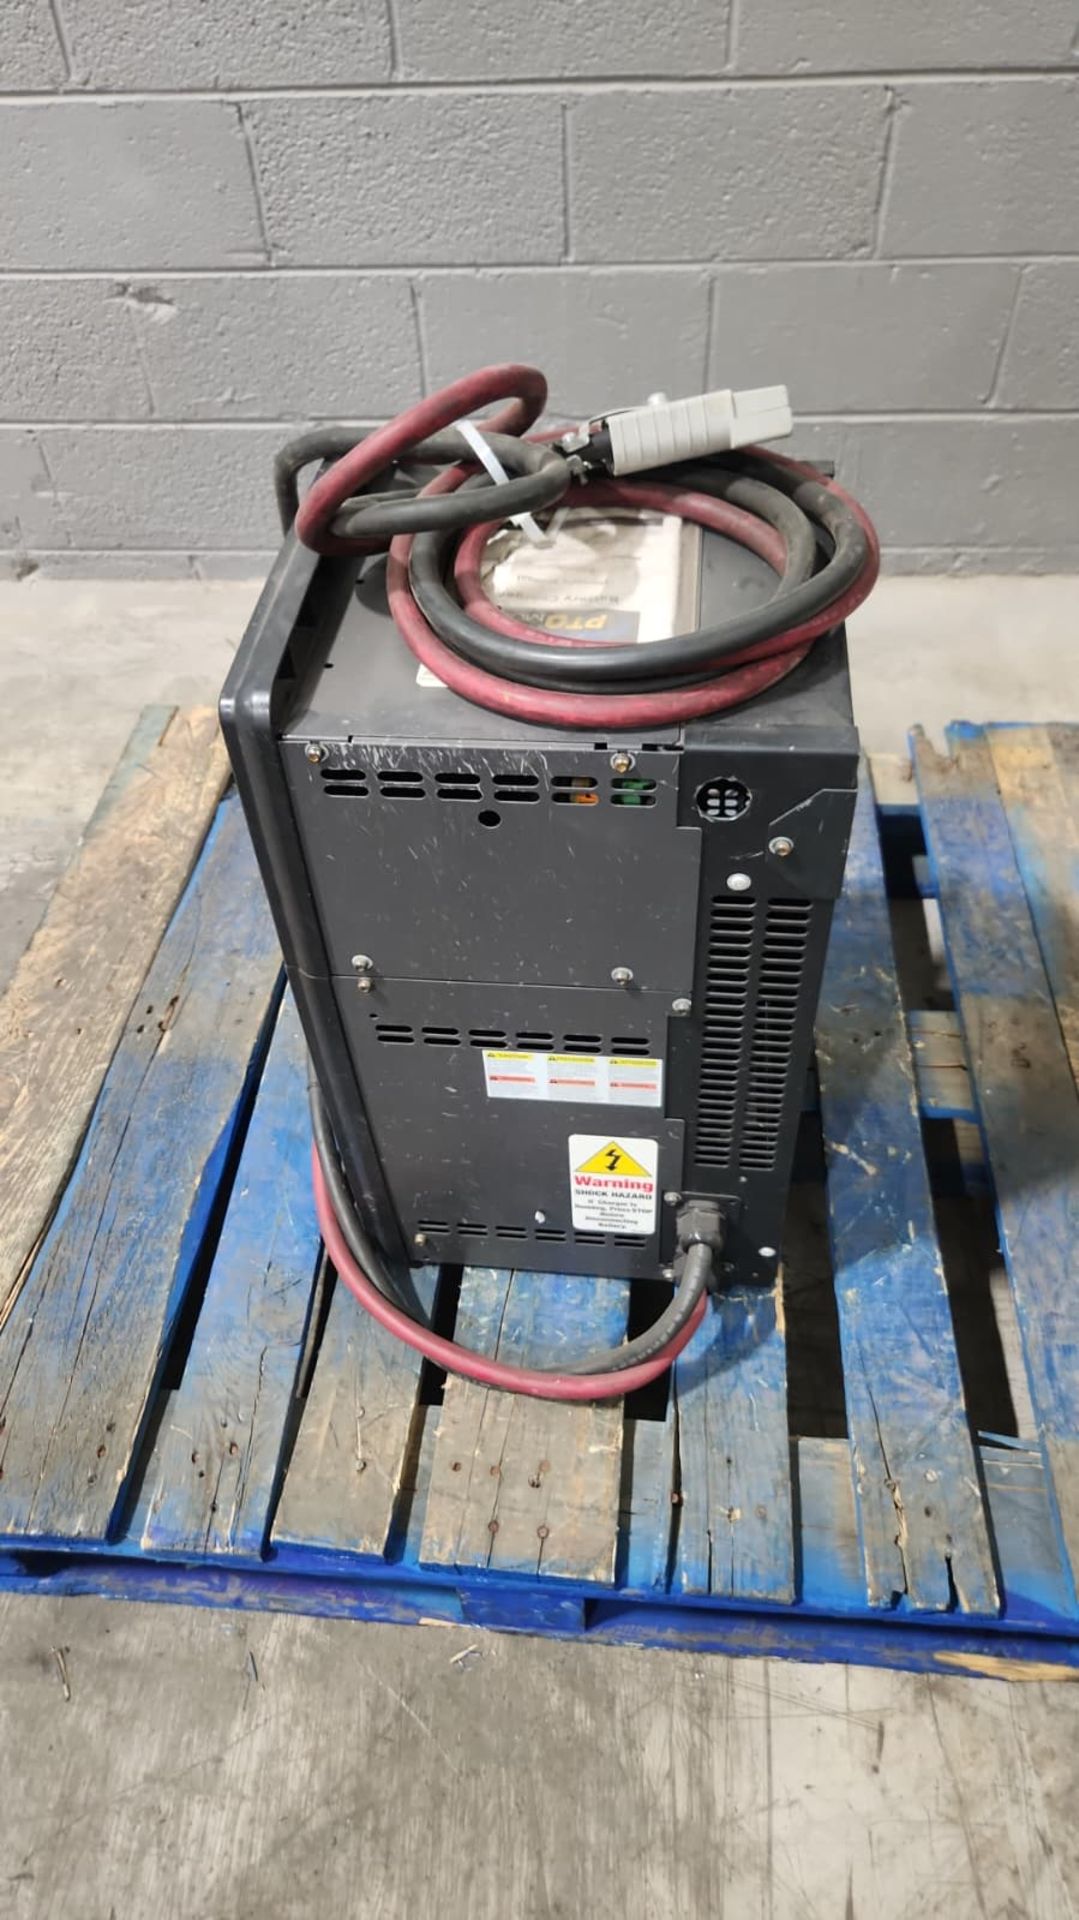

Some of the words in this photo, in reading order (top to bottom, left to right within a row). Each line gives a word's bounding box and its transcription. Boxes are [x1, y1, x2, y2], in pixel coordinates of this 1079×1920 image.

[575, 1176, 653, 1192] Warning
[575, 1189, 608, 1197] SHOCK
[611, 1191, 653, 1200] HAZARD
